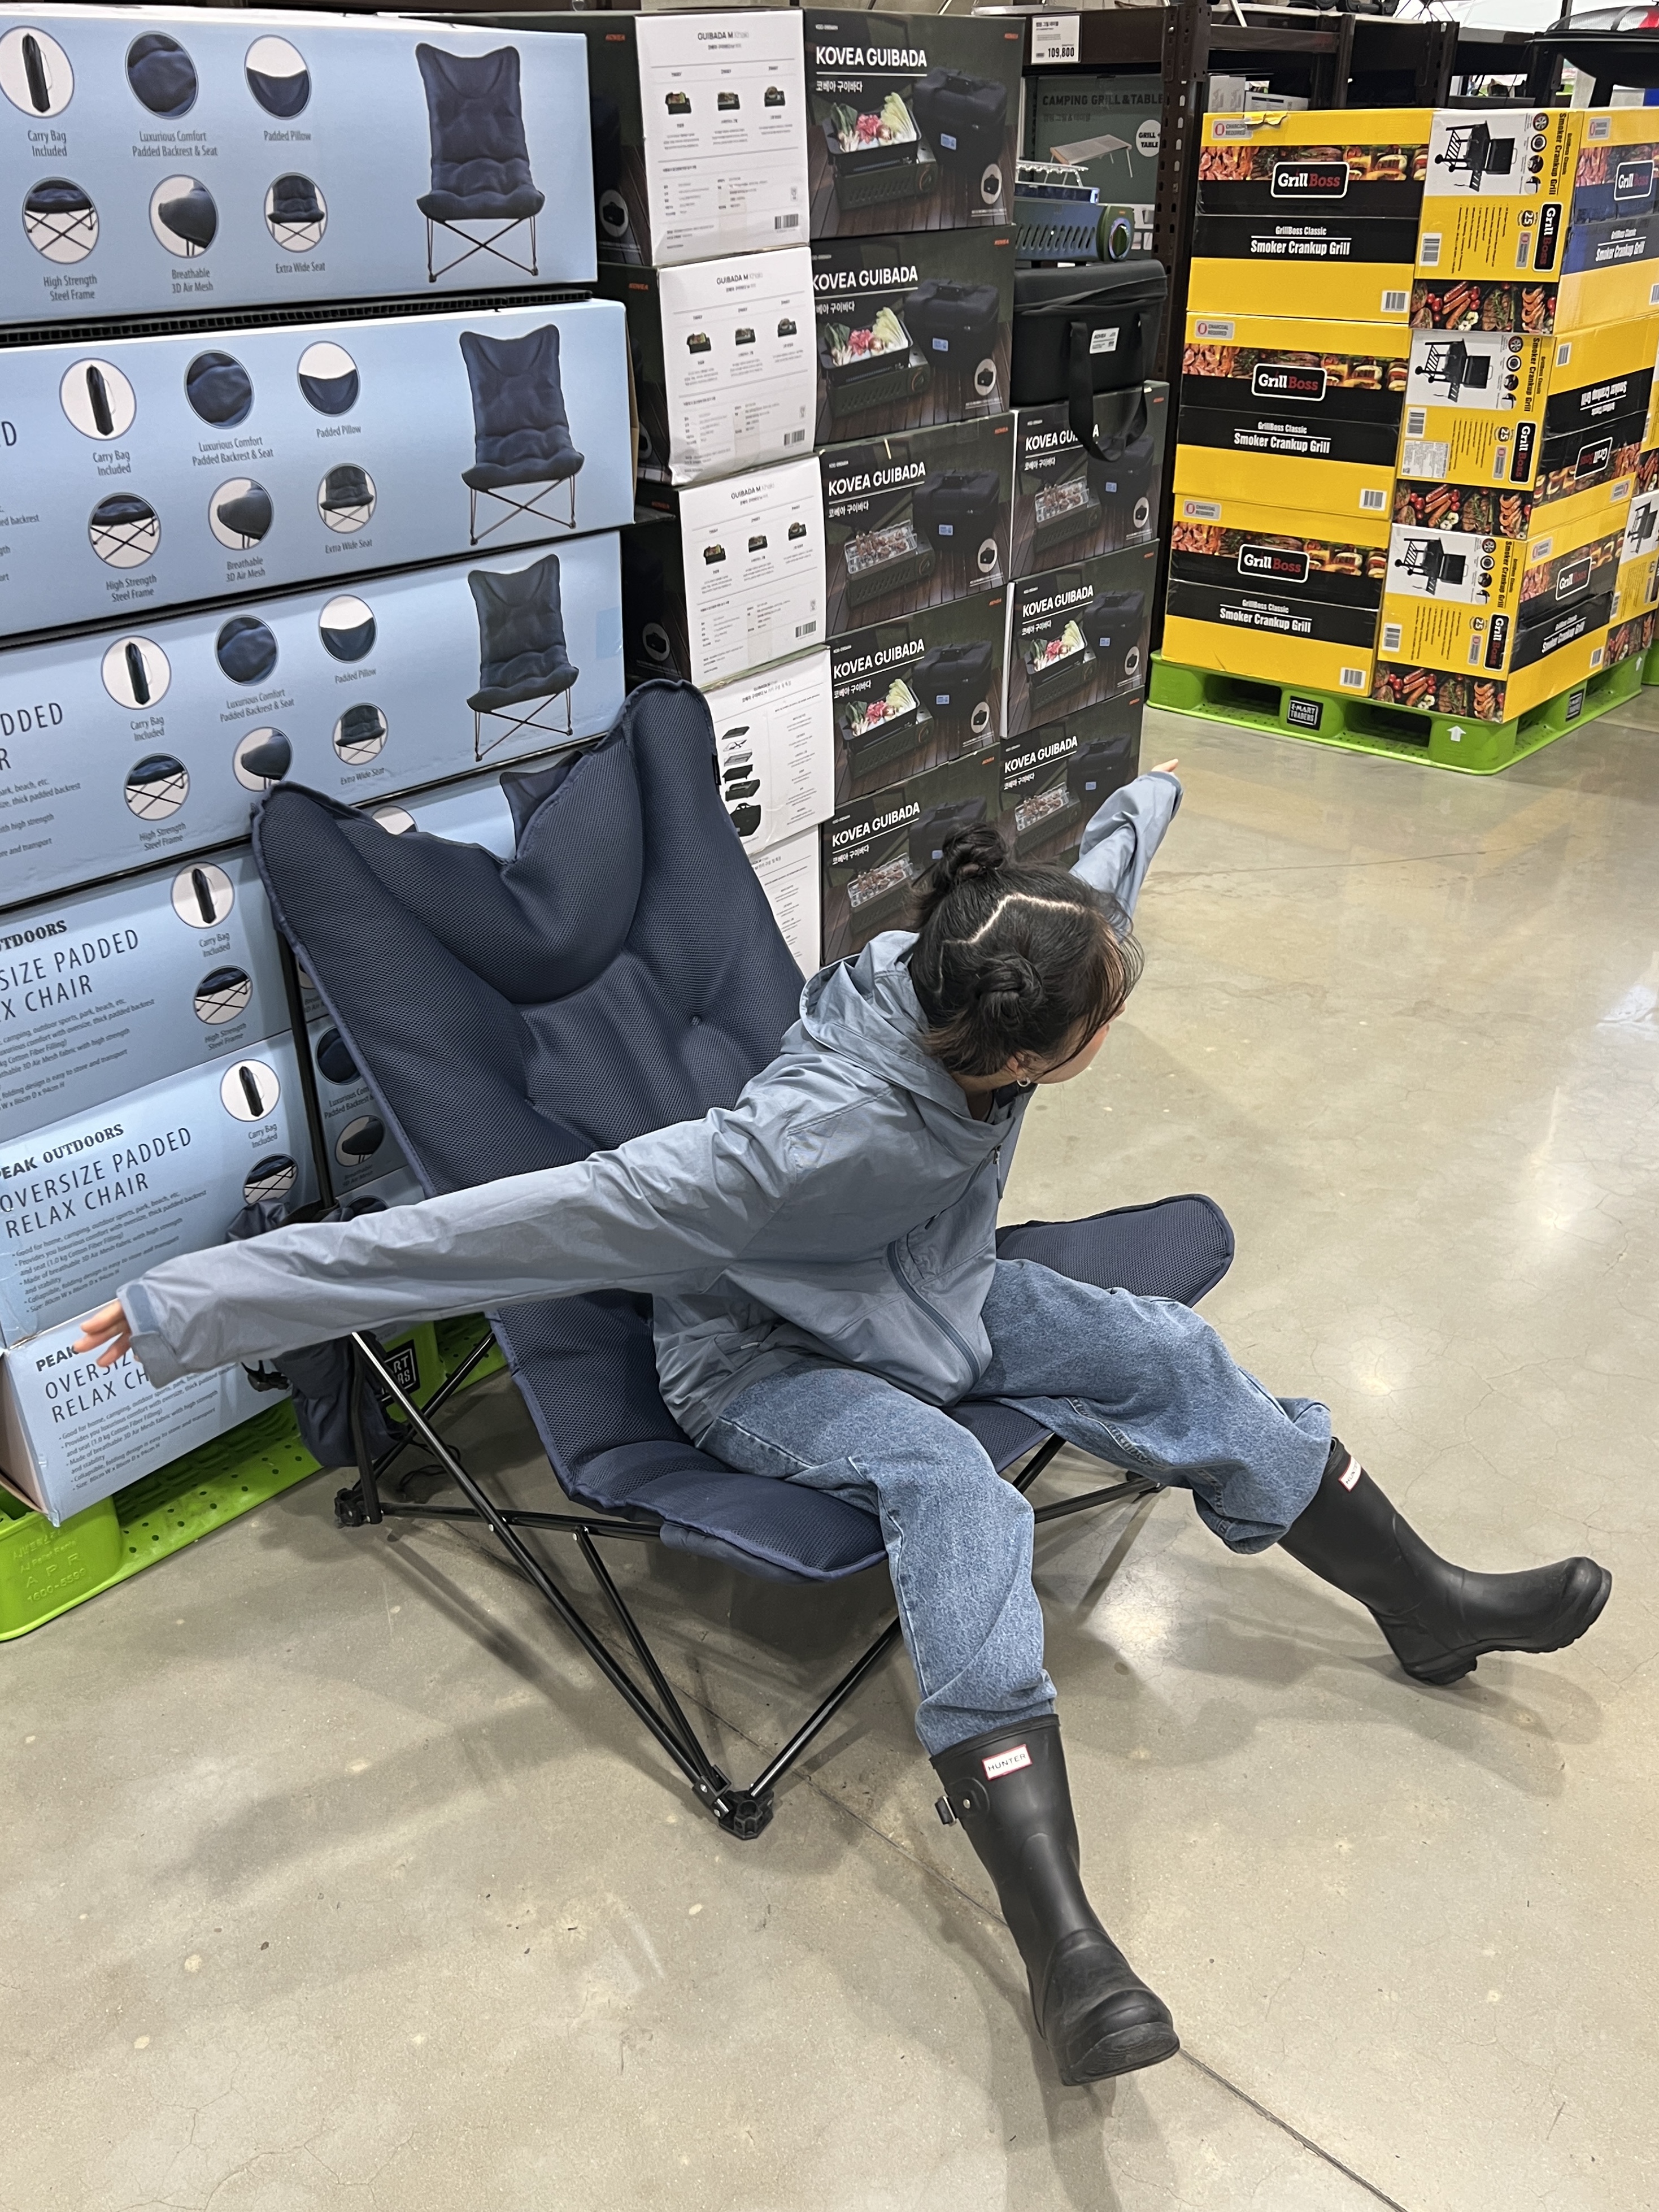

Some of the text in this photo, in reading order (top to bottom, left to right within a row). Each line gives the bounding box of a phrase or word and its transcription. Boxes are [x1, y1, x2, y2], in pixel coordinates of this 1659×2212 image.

[816, 46, 928, 67] KOVEA GUIBADA
[1048, 47, 1074, 59] 109,800
[816, 80, 863, 93] 코베아 구이바다
[1043, 95, 1088, 106] CAMPING
[28, 130, 66, 144] Carry Bag
[140, 131, 207, 142] Luxurious Comfort
[264, 131, 311, 141] Padded Pillow
[32, 145, 67, 157] Included
[132, 145, 217, 157] Padded Backrest & Seat
[1549, 112, 1566, 195] Smoker Crankup Grill
[1278, 172, 1340, 187] GrillBoss
[1525, 212, 1533, 224] 25
[1275, 226, 1327, 236] GrillBoss Classic
[1251, 240, 1351, 256] Smoker Crankup Grill
[1634, 241, 1645, 255] Grill
[172, 268, 210, 279] Breathable
[276, 261, 325, 273] Extra Wide Seat
[43, 274, 97, 289] High Strength
[812, 266, 918, 290] KOVEA GUIBADA
[172, 281, 213, 293] 3D Air Mesh
[50, 289, 95, 301] Steel Frame
[816, 301, 855, 314] 베아 구이바다
[1530, 337, 1540, 364] Smoker
[1258, 373, 1318, 391] GrillBoss
[1526, 367, 1536, 395] Crankup
[316, 426, 341, 438] Padded
[1258, 421, 1307, 434] GrillBoss Classic
[1500, 428, 1509, 440] 25
[198, 437, 263, 452] Luxurious Comfort
[1025, 432, 1058, 451] KOVEA
[1234, 433, 1330, 453] Smoker Crankup Grill
[93, 450, 130, 463] Carry Bag
[192, 454, 220, 466] Padded
[220, 451, 250, 463] Backrest
[258, 448, 273, 458] Seat
[97, 463, 131, 476] Included
[829, 462, 926, 497] KOVEA GUIBADA
[829, 501, 869, 518] 코베아 구이바다
[1503, 541, 1512, 566] Smoker
[1244, 554, 1301, 573] GrillBoss
[106, 574, 157, 591] High Strength
[1499, 567, 1509, 593] Crankup
[111, 588, 154, 602] Steel Frame
[1022, 585, 1093, 617] KOVEA GUIBADA
[1242, 599, 1289, 614] GrillBoss Classic
[1220, 608, 1311, 633] Smoker Crankup Grill
[1475, 618, 1483, 629] 25
[834, 639, 925, 679] KOVEA GUIBADA
[834, 680, 872, 698] 코베아 구이바다
[130, 716, 164, 731] Carry Bag
[134, 727, 165, 742] Included
[1004, 736, 1077, 773] KOVEA GUIBADA
[833, 802, 920, 847] KOVEA GUIBADA
[849, 844, 869, 859] 구이바다
[54, 929, 139, 972] PADDED
[25, 975, 93, 1012] CHAIR
[42, 1124, 124, 1163] OUTDOORS
[1, 1127, 192, 1213] OVERSIZE PADDED
[5, 1172, 149, 1238] RELAX CHAIR
[52, 1381, 116, 1423] RELAX
[988, 1753, 1026, 1771] HUNTER
